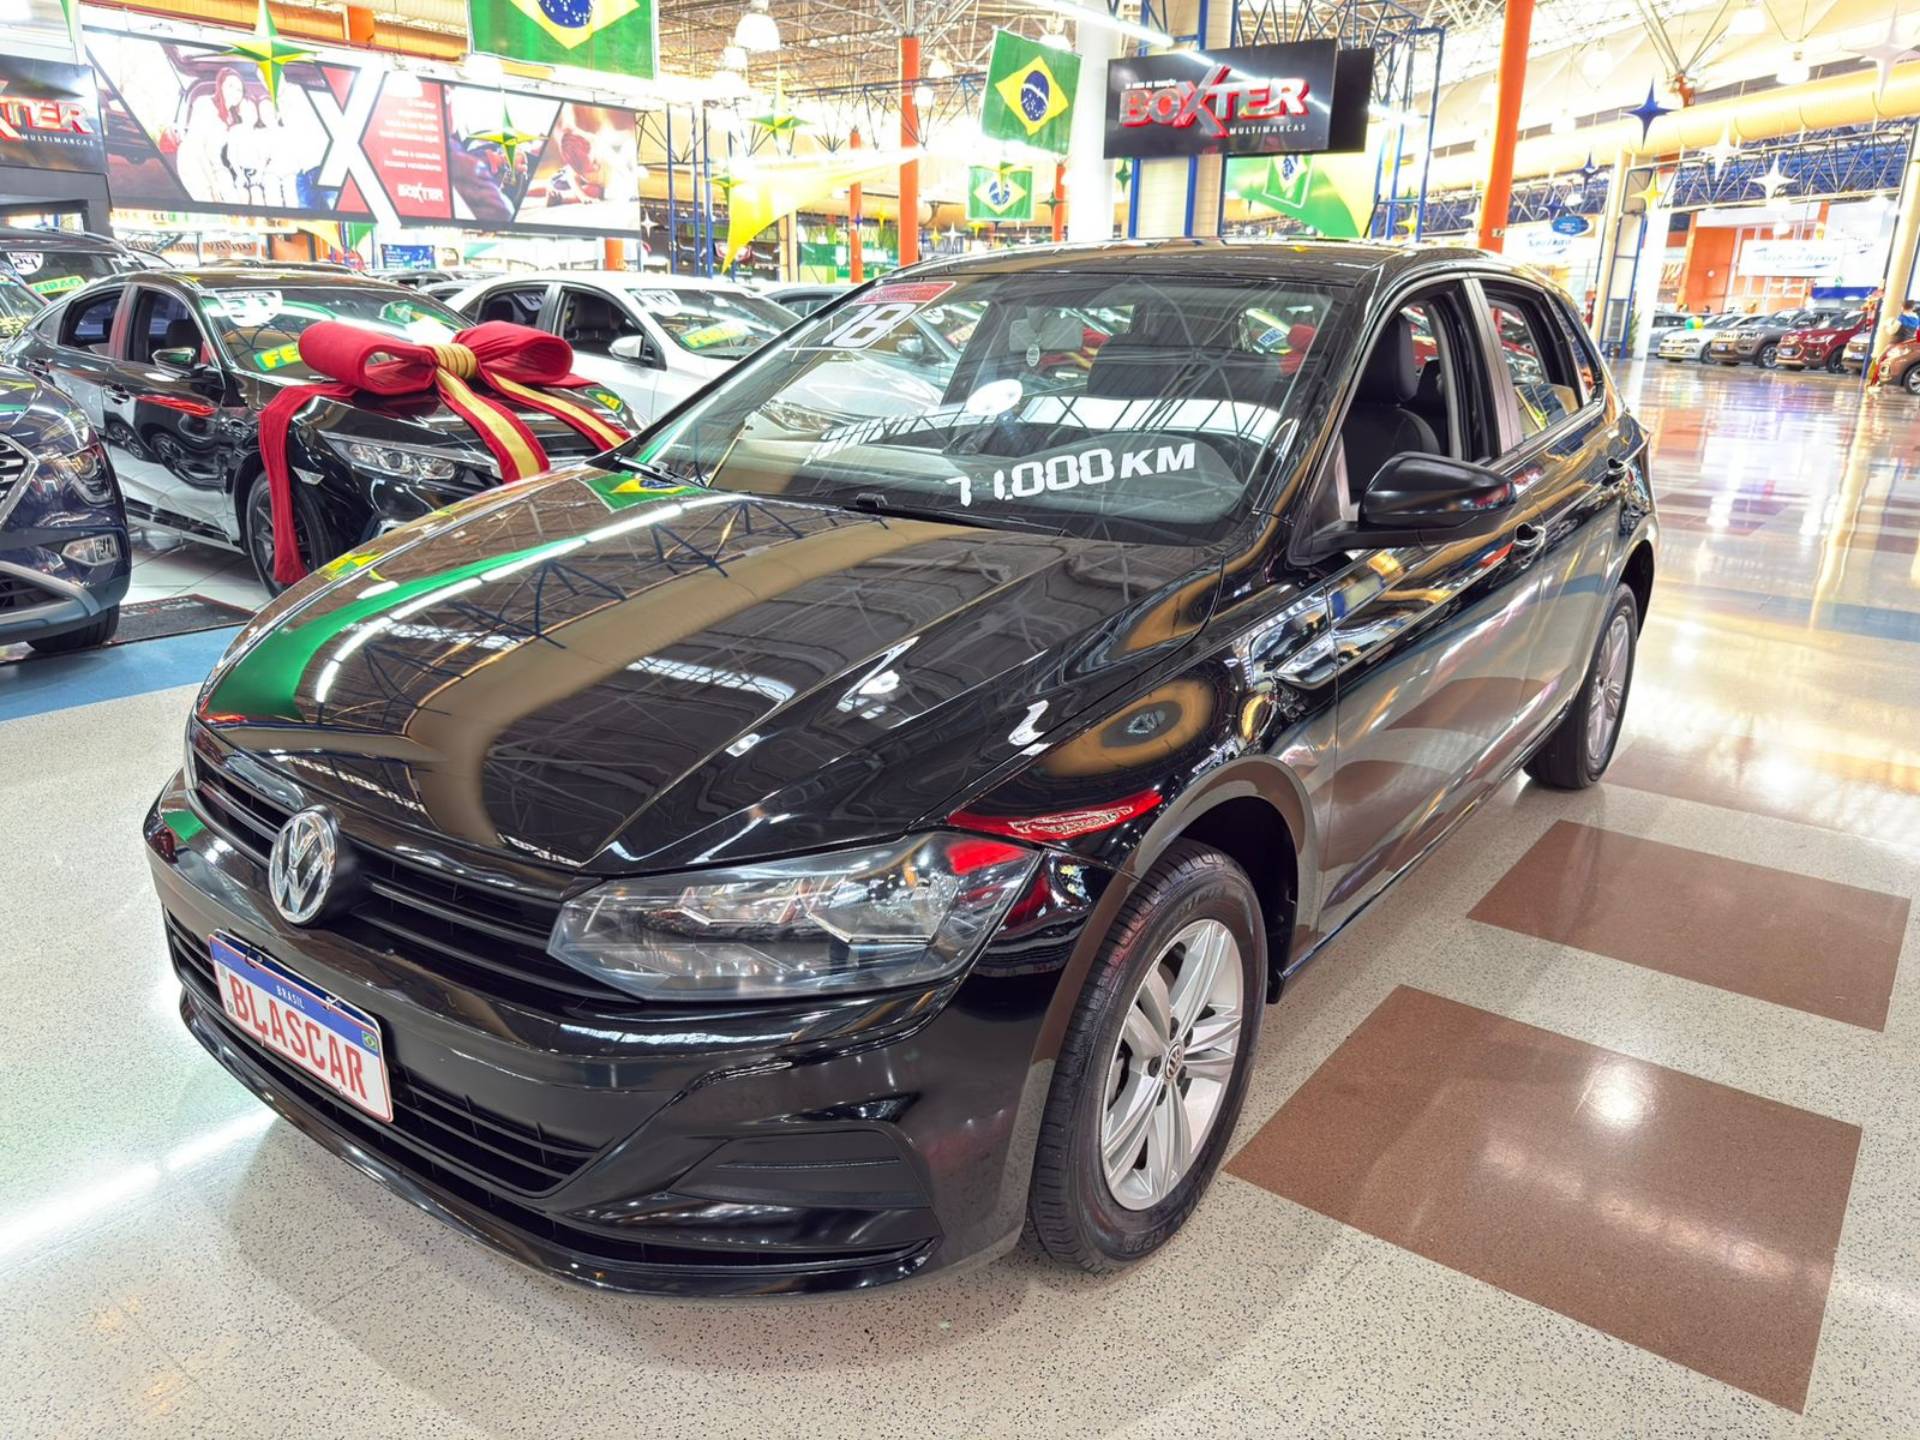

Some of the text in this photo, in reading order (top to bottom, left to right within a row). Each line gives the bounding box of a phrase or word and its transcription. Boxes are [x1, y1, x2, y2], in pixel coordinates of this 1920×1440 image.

[1119, 64, 1309, 138] BOXTER
[1229, 123, 1306, 135] MULTIMARCAS
[820, 303, 917, 348] 18
[1120, 442, 1196, 479] KM
[275, 984, 304, 1010] BRASIL
[228, 973, 368, 1101] BLASCAR
